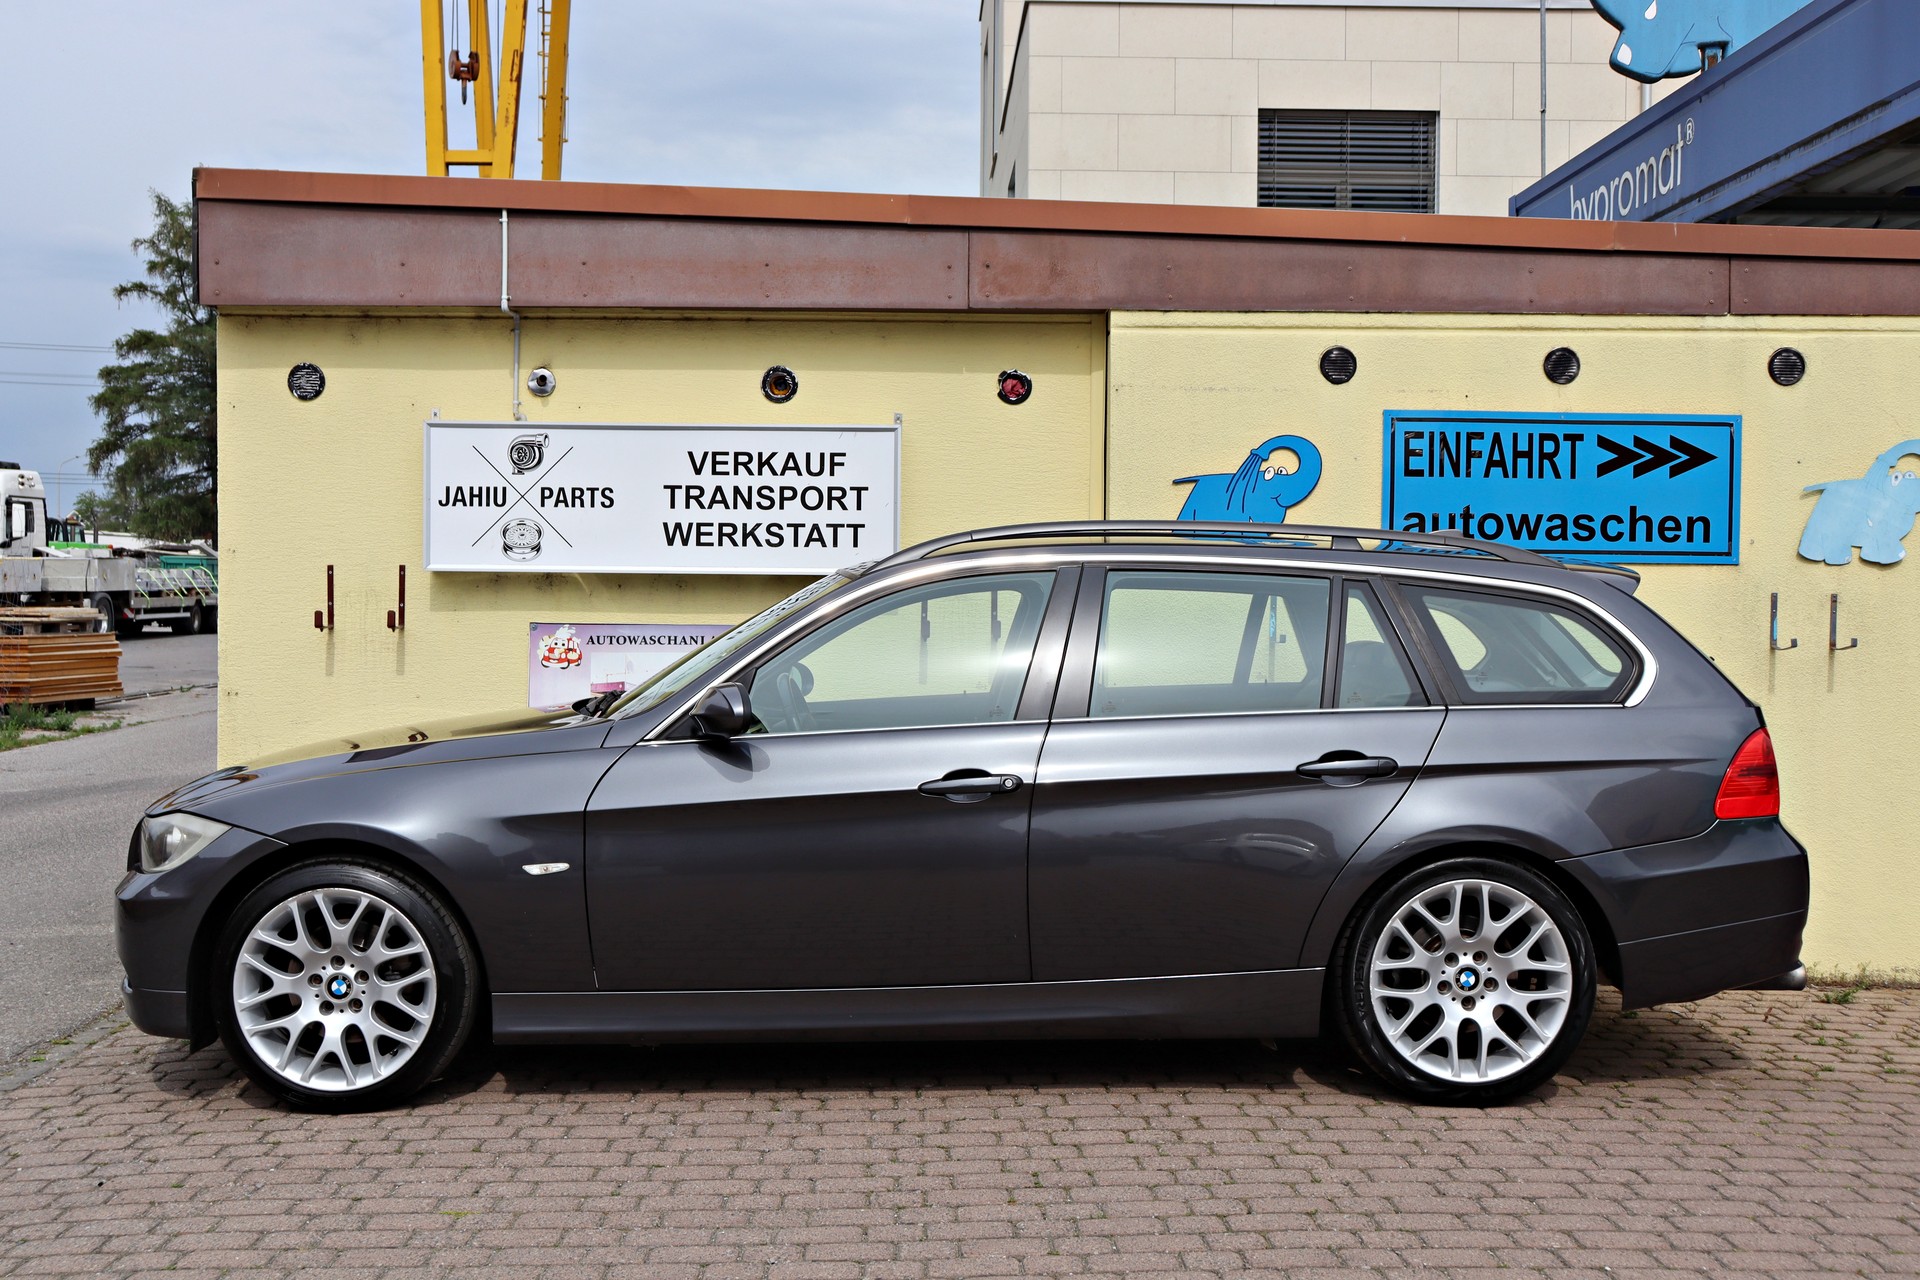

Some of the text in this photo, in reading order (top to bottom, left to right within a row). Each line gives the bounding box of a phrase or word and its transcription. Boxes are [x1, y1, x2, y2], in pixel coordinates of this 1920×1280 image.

[687, 451, 847, 477] VERKAUF
[1403, 430, 1585, 480] EINFAHRT
[438, 485, 615, 509] JAHIU PARTS
[663, 484, 869, 511] TRANSPORT
[662, 522, 866, 548] WERKSTATT
[1402, 504, 1711, 544] autowaschen
